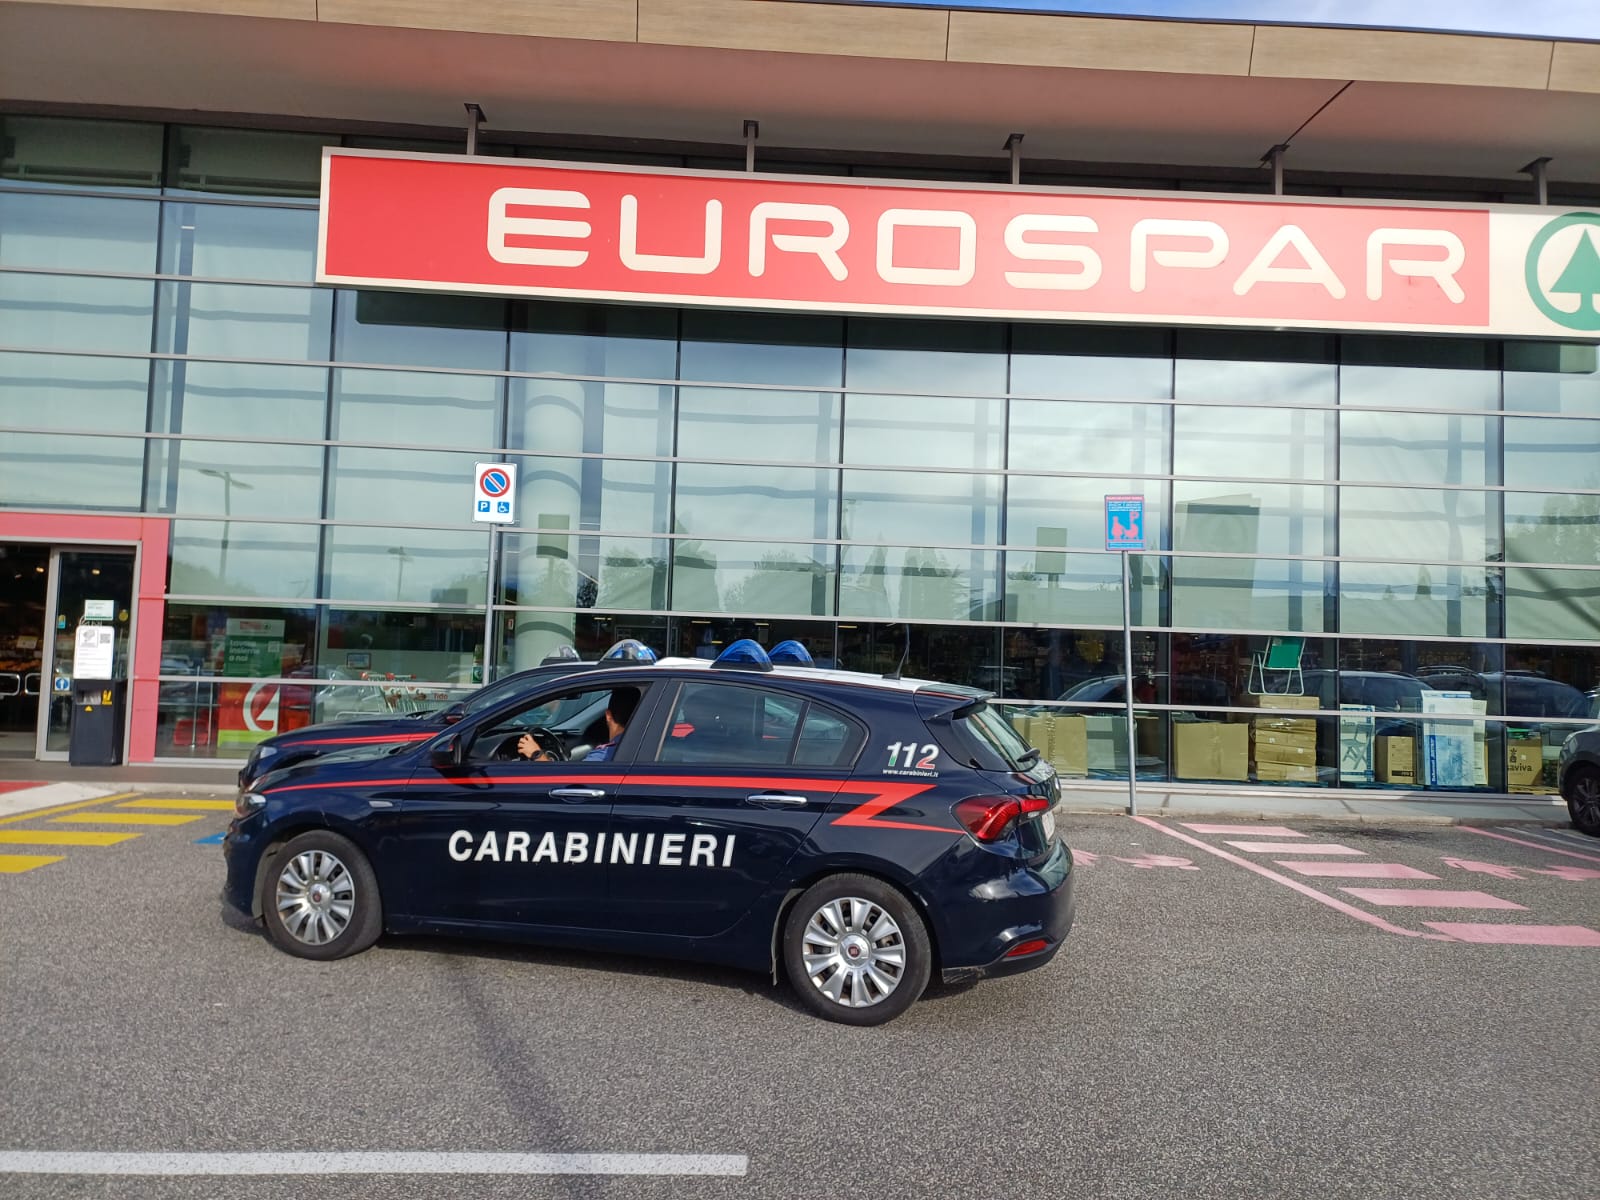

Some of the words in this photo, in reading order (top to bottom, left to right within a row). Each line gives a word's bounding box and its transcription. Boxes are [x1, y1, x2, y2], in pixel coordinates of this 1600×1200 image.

[487, 187, 1466, 304] EUROSPAR
[480, 501, 489, 511] P
[887, 741, 940, 769] 112
[882, 768, 939, 778] www.carabinieri.it
[448, 829, 737, 867] CARABINIERI
